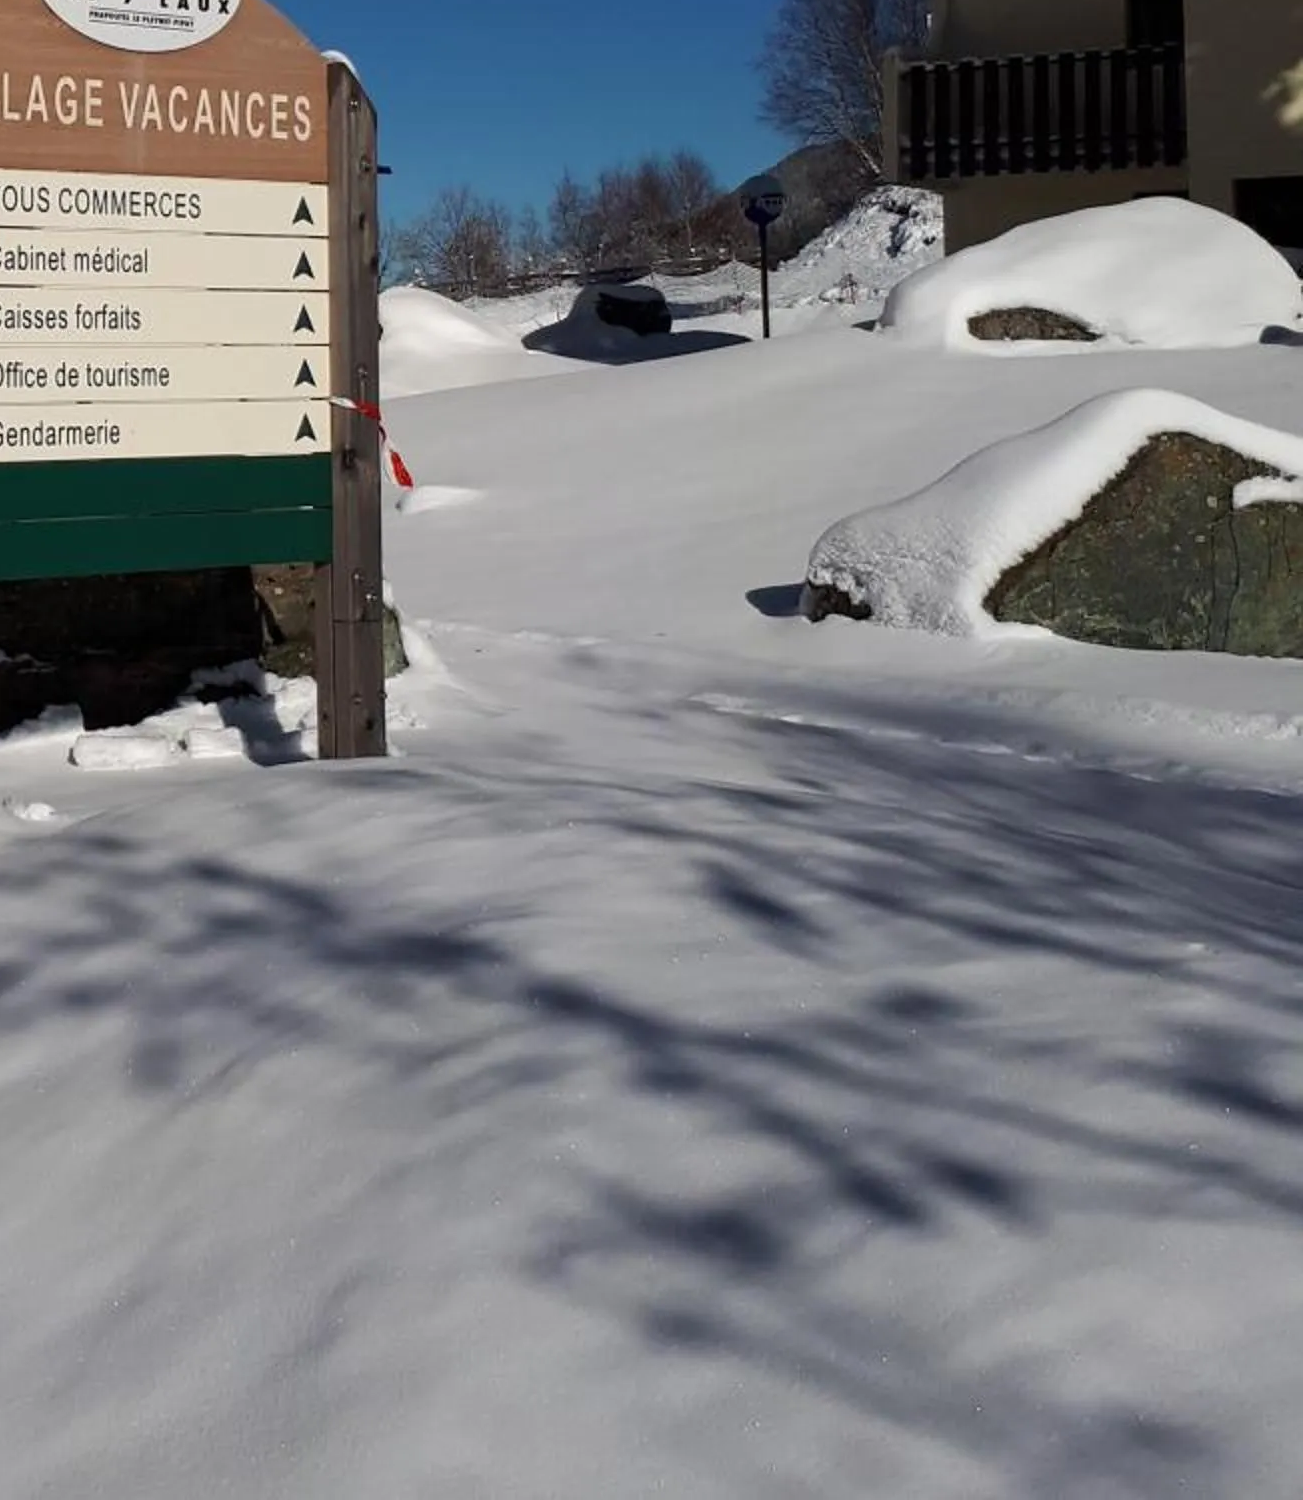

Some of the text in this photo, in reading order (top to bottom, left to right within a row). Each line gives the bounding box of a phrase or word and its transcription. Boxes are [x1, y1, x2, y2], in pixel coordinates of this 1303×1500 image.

[118, 81, 312, 142] VACANCES
[58, 187, 202, 219] COMMERCES
[74, 247, 148, 273] médical
[75, 303, 141, 331] forfaits
[55, 361, 80, 387] de
[87, 361, 170, 387] tourisme
